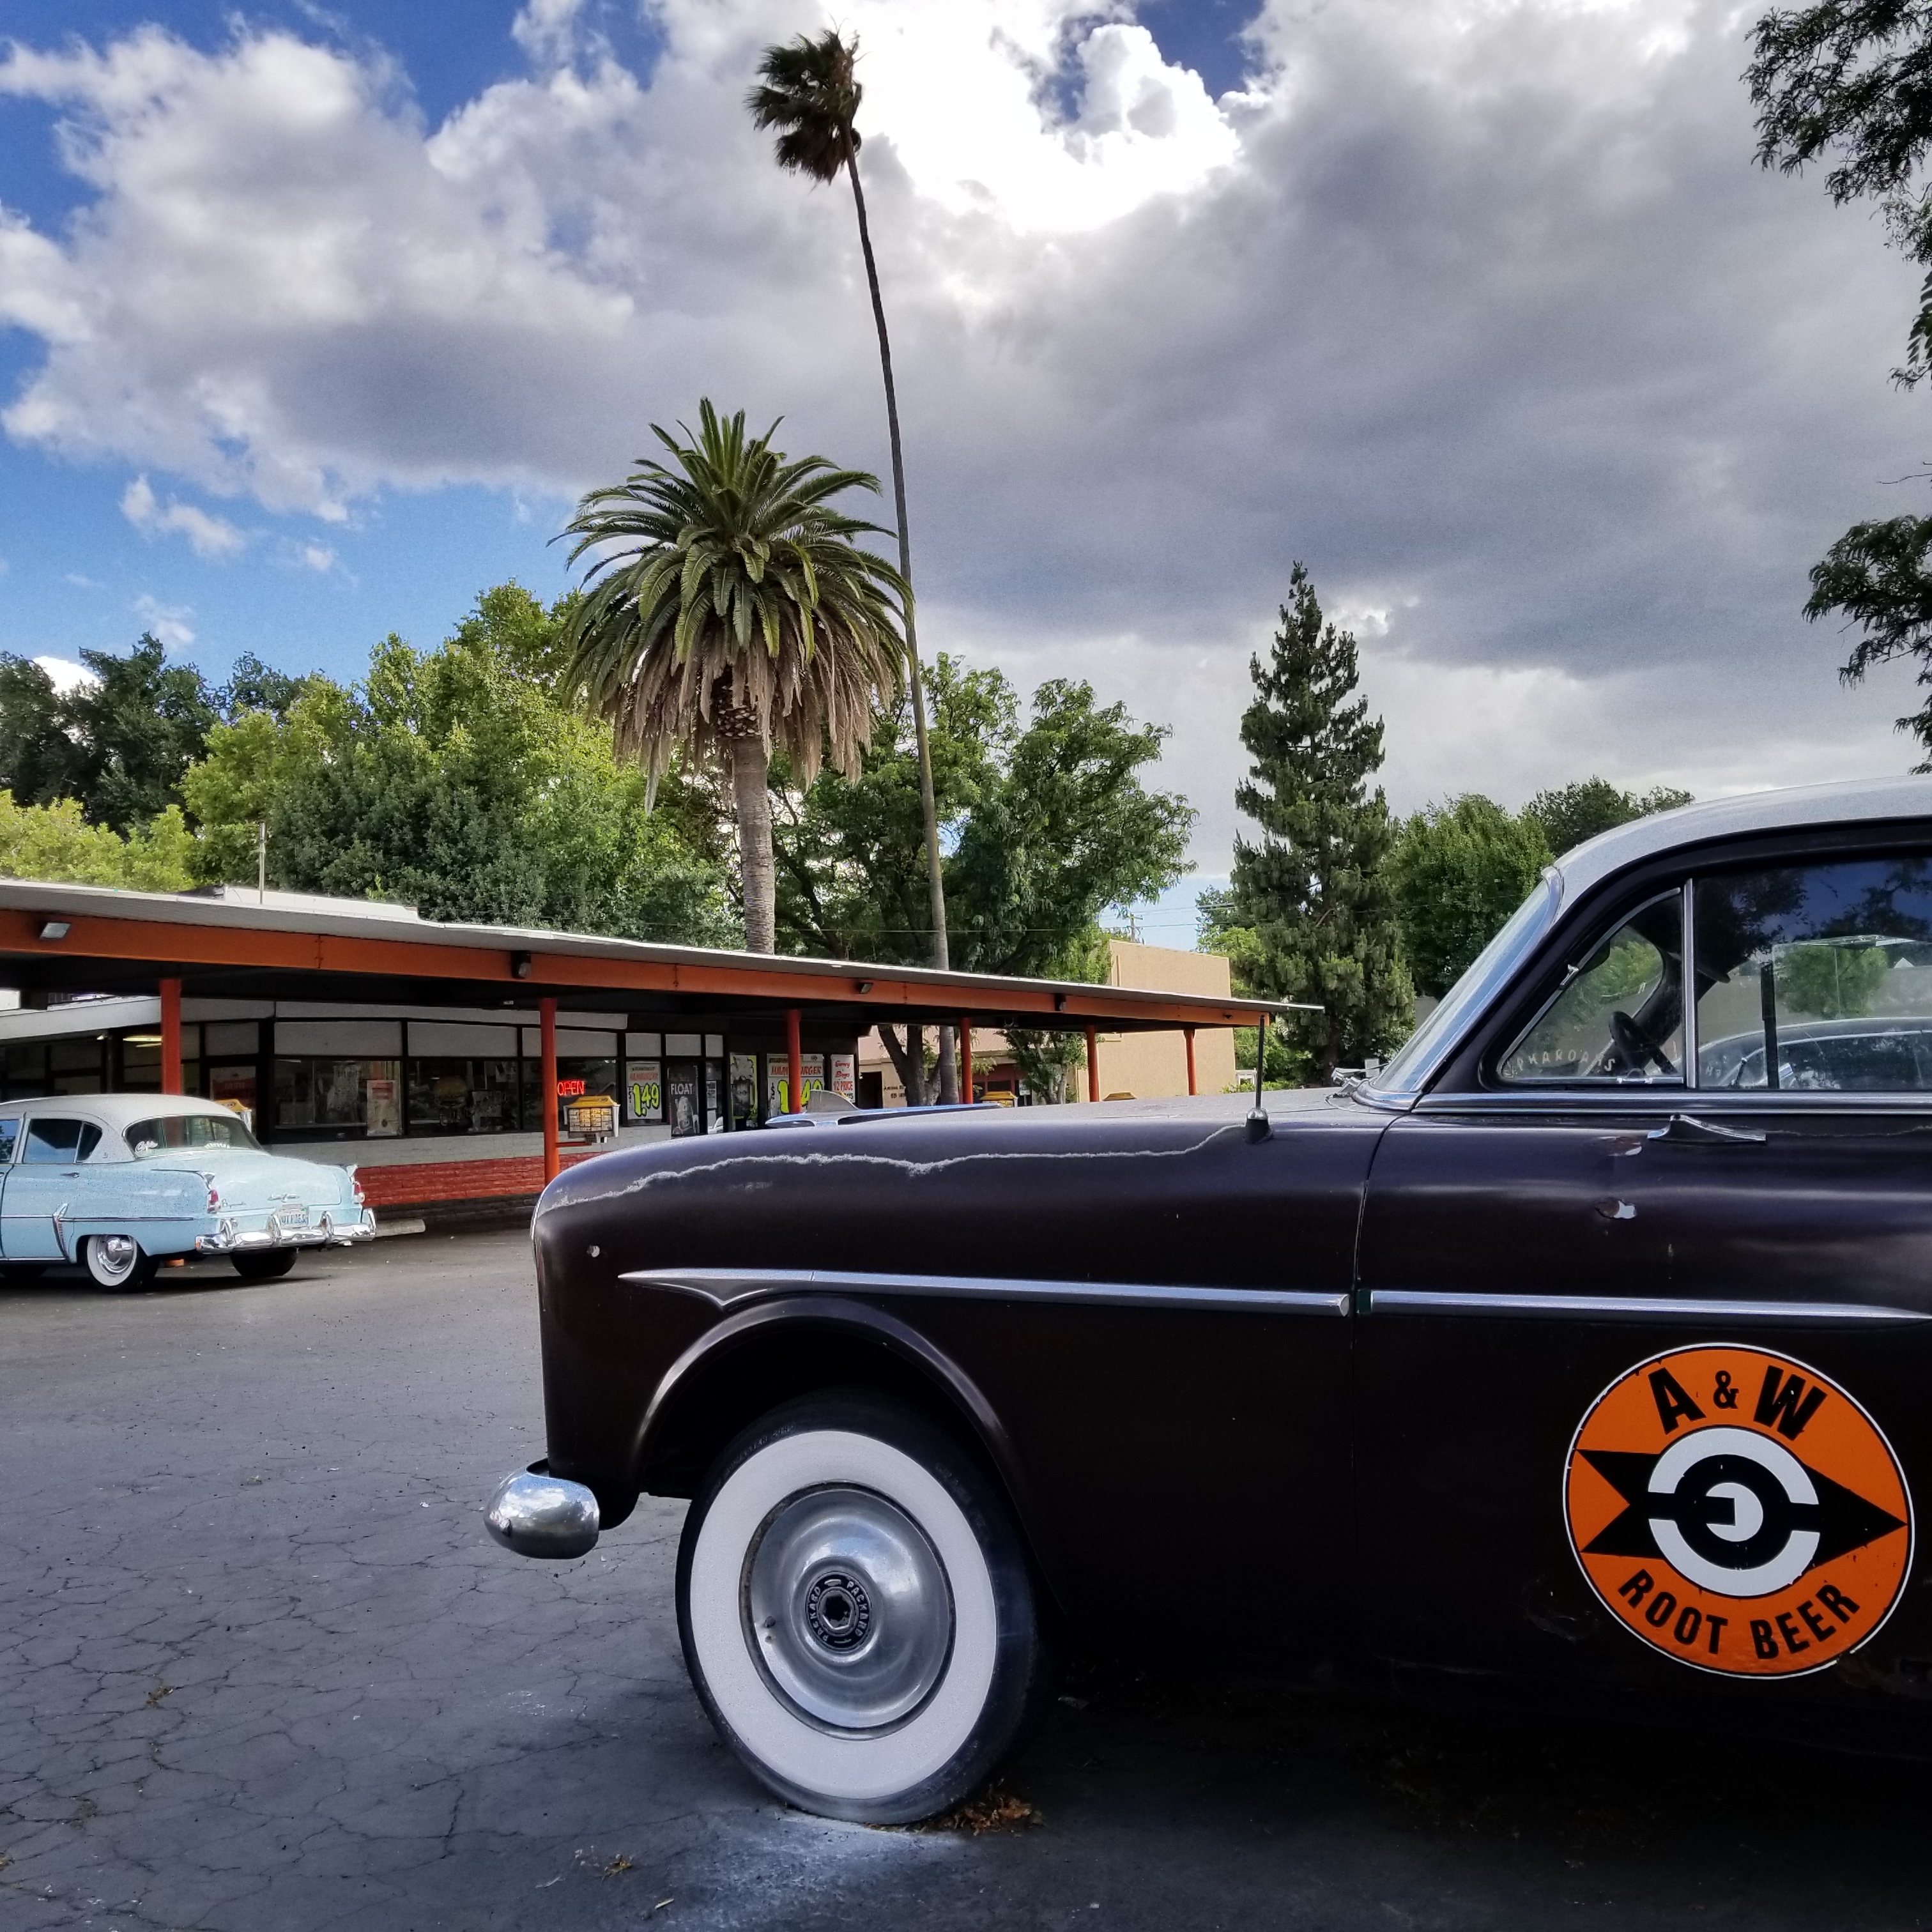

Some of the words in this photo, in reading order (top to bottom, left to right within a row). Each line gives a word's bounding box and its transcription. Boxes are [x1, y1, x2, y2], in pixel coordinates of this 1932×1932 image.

[557, 1080, 585, 1096] OPEN
[632, 1082, 660, 1117] 1.49
[671, 1083, 693, 1094] FLOAT
[1648, 1367, 1706, 1434] A
[1713, 1370, 1739, 1409] &
[1754, 1365, 1828, 1441] W
[809, 1586, 829, 1642] PACKARD
[847, 1581, 869, 1637] PACKARD
[1618, 1568, 1728, 1655] ROOT
[1749, 1584, 1860, 1660] BEER
